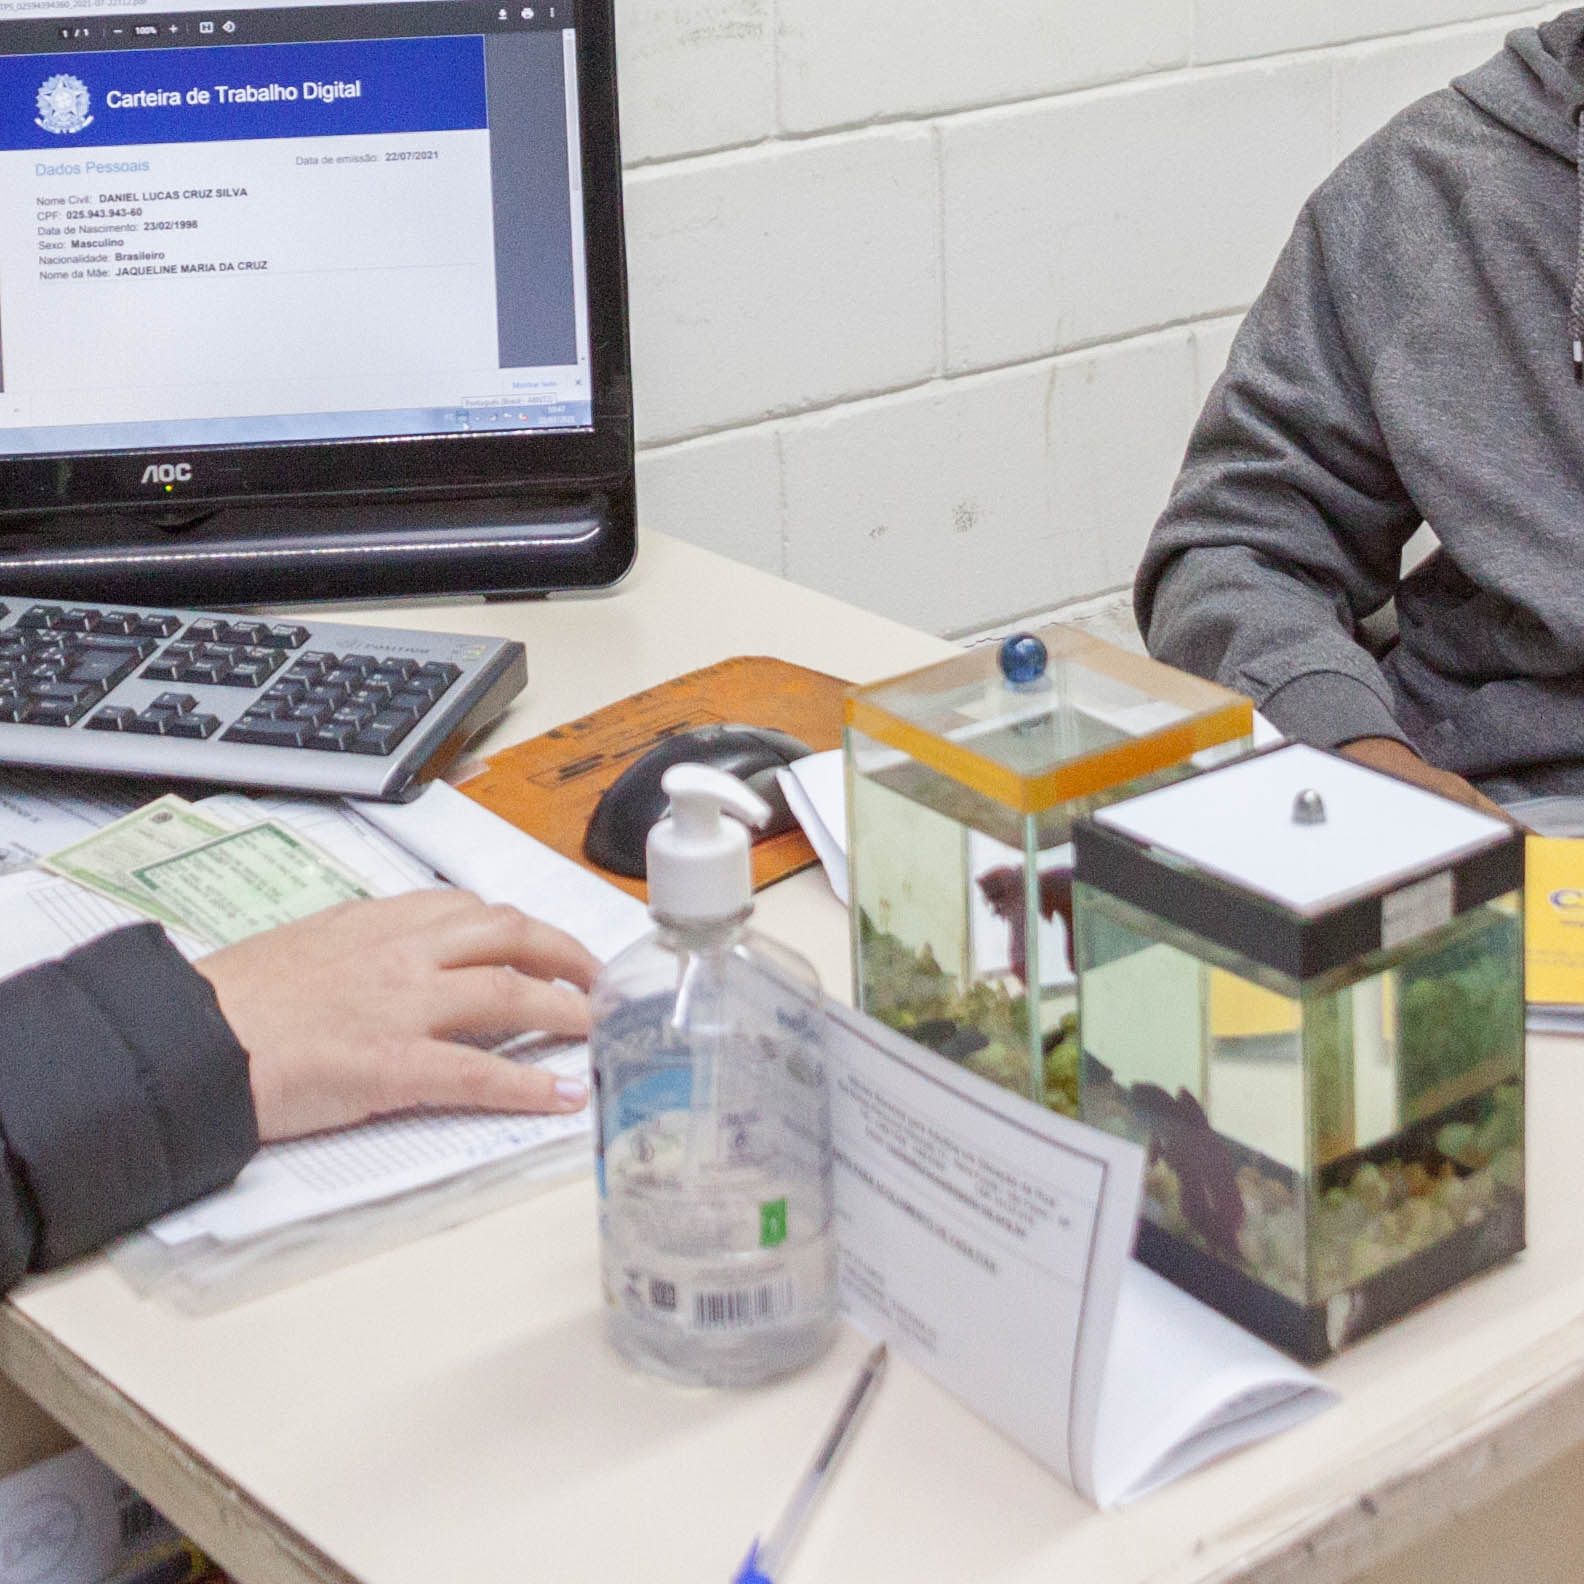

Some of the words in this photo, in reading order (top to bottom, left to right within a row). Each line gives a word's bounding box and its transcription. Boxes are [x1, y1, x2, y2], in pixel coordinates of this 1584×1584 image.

[135, 26, 157, 35] 100%
[106, 89, 181, 109] Carteira
[186, 87, 210, 105] de
[215, 83, 298, 103] Trabalho
[303, 80, 361, 104] Digital
[296, 155, 319, 166] Data
[321, 156, 334, 165] de
[385, 151, 439, 162] 22/07/2021
[36, 163, 81, 176] Dados
[86, 161, 150, 173] Pessoais
[36, 197, 66, 206] Nome
[99, 193, 139, 203] DANIEL
[142, 191, 180, 201] LUCAS
[183, 189, 213, 199] CRUZ
[216, 188, 248, 198] SILVA
[37, 226, 61, 236] Data
[64, 225, 76, 234] de
[79, 223, 138, 234] Nascimento:
[38, 241, 66, 251] Sexo:
[71, 238, 124, 248] Masculino
[39, 254, 109, 265] Nacionalidade:
[115, 252, 165, 262] Brasileiro
[40, 270, 69, 280] Nome
[71, 269, 84, 279] da
[115, 264, 178, 276] JAQUELINE
[181, 263, 216, 273] MARIA
[219, 262, 235, 272] DA
[237, 260, 268, 271] CRUZ
[141, 462, 192, 484] AOC
